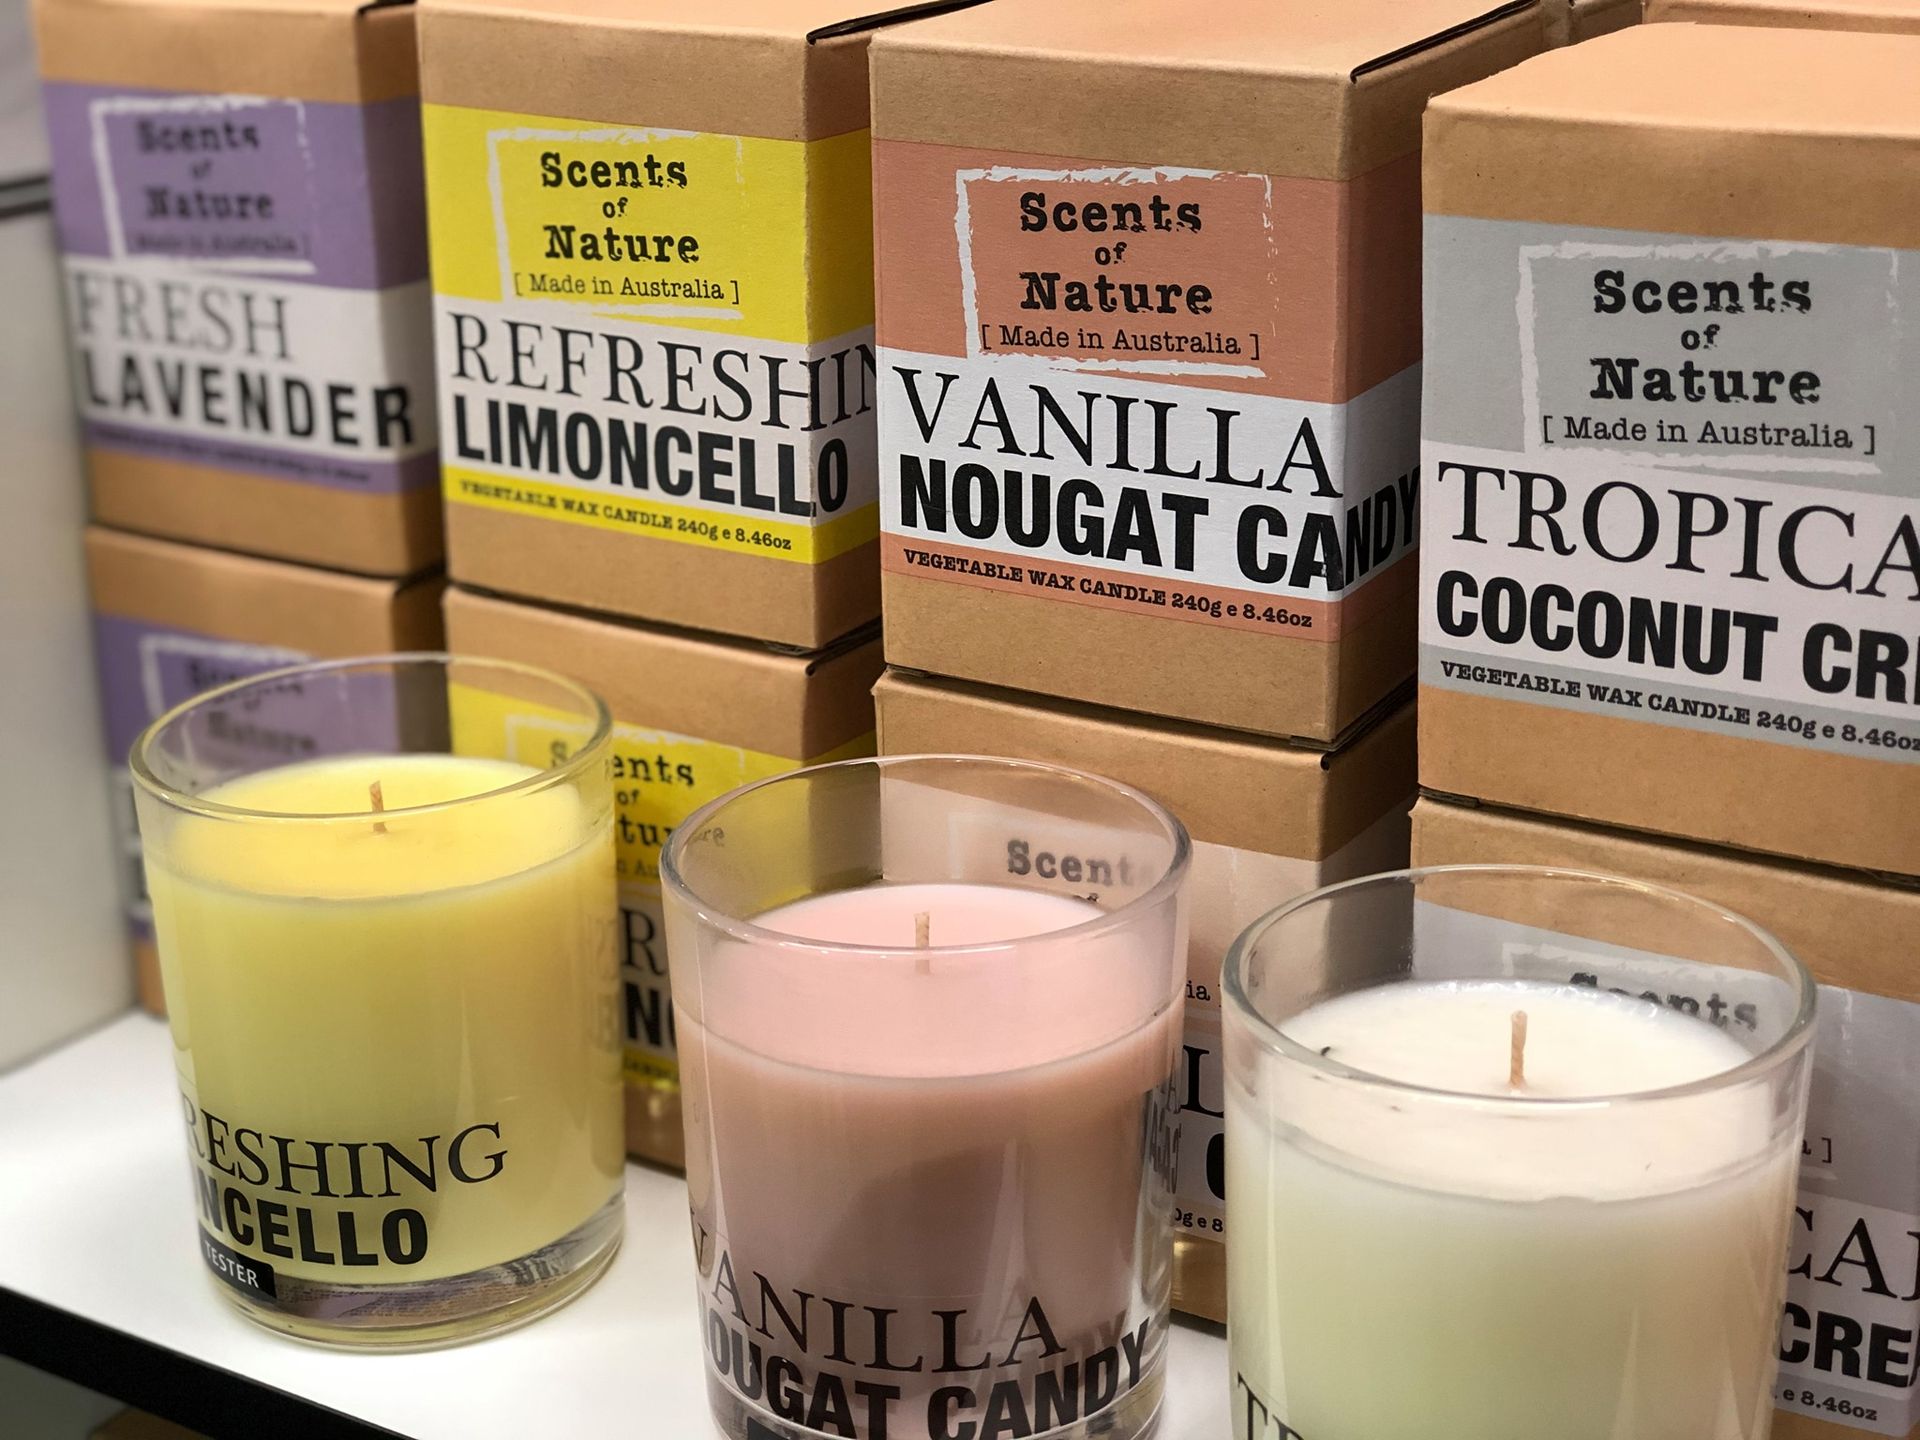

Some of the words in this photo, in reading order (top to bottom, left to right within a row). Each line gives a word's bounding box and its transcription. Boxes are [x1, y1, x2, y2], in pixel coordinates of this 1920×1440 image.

[137, 119, 260, 153] Scents
[541, 152, 688, 189] Scents
[146, 187, 274, 220] Nature
[602, 197, 628, 219] of
[1020, 192, 1202, 233] Scents
[544, 225, 700, 263] Nature
[1095, 242, 1127, 265] of
[530, 273, 585, 295] Made
[592, 276, 613, 295] in
[620, 278, 725, 300] Australia
[1020, 272, 1213, 315] Nature
[1593, 270, 1812, 314] Scents
[73, 271, 292, 361] FRESH
[1681, 324, 1720, 350] of
[999, 326, 1069, 348] Made
[1077, 328, 1104, 350] in
[1113, 328, 1241, 355] Australia
[448, 312, 877, 432] REFRESHIN
[1590, 357, 1822, 404] Nature
[82, 349, 414, 448] LAVENDER
[892, 366, 1343, 499] VANILLA
[1564, 416, 1647, 442] Made
[1656, 419, 1688, 443] in
[1697, 420, 1853, 449] Australia
[454, 394, 849, 518] LIMONCELLO
[460, 479, 556, 508] VEGETABLE
[560, 496, 600, 516] WAX
[603, 505, 673, 530] CANDLE
[677, 518, 718, 541] 240g
[735, 528, 792, 550] 8.46oz
[899, 454, 1209, 572] NOUGAT
[1237, 464, 1421, 592] CANDY
[1437, 460, 1920, 601] TROPICA
[903, 548, 1023, 583] VEGETABLE
[1027, 568, 1075, 591] WAX
[1080, 575, 1166, 606] CANDLE
[1172, 592, 1222, 619] 240g
[1242, 604, 1313, 628] 8.46oz
[1436, 569, 1779, 683] COCONUT
[1802, 622, 1920, 706] CR
[1440, 660, 1581, 699] VEGETABLE
[1586, 683, 1643, 708] WAX
[1648, 693, 1751, 727] CANDLE
[1757, 710, 1817, 740] 240g
[1841, 723, 1920, 752] 8.46oz
[550, 741, 695, 787] Sents
[617, 789, 640, 805] of
[1007, 839, 1140, 887] Scent
[204, 1240, 260, 1289] TESTER
[1779, 1302, 1920, 1388] CRE
[703, 1300, 900, 1440] OUGAT
[928, 1316, 1150, 1440] CANDY
[1801, 1390, 1878, 1421] 8.46oz
